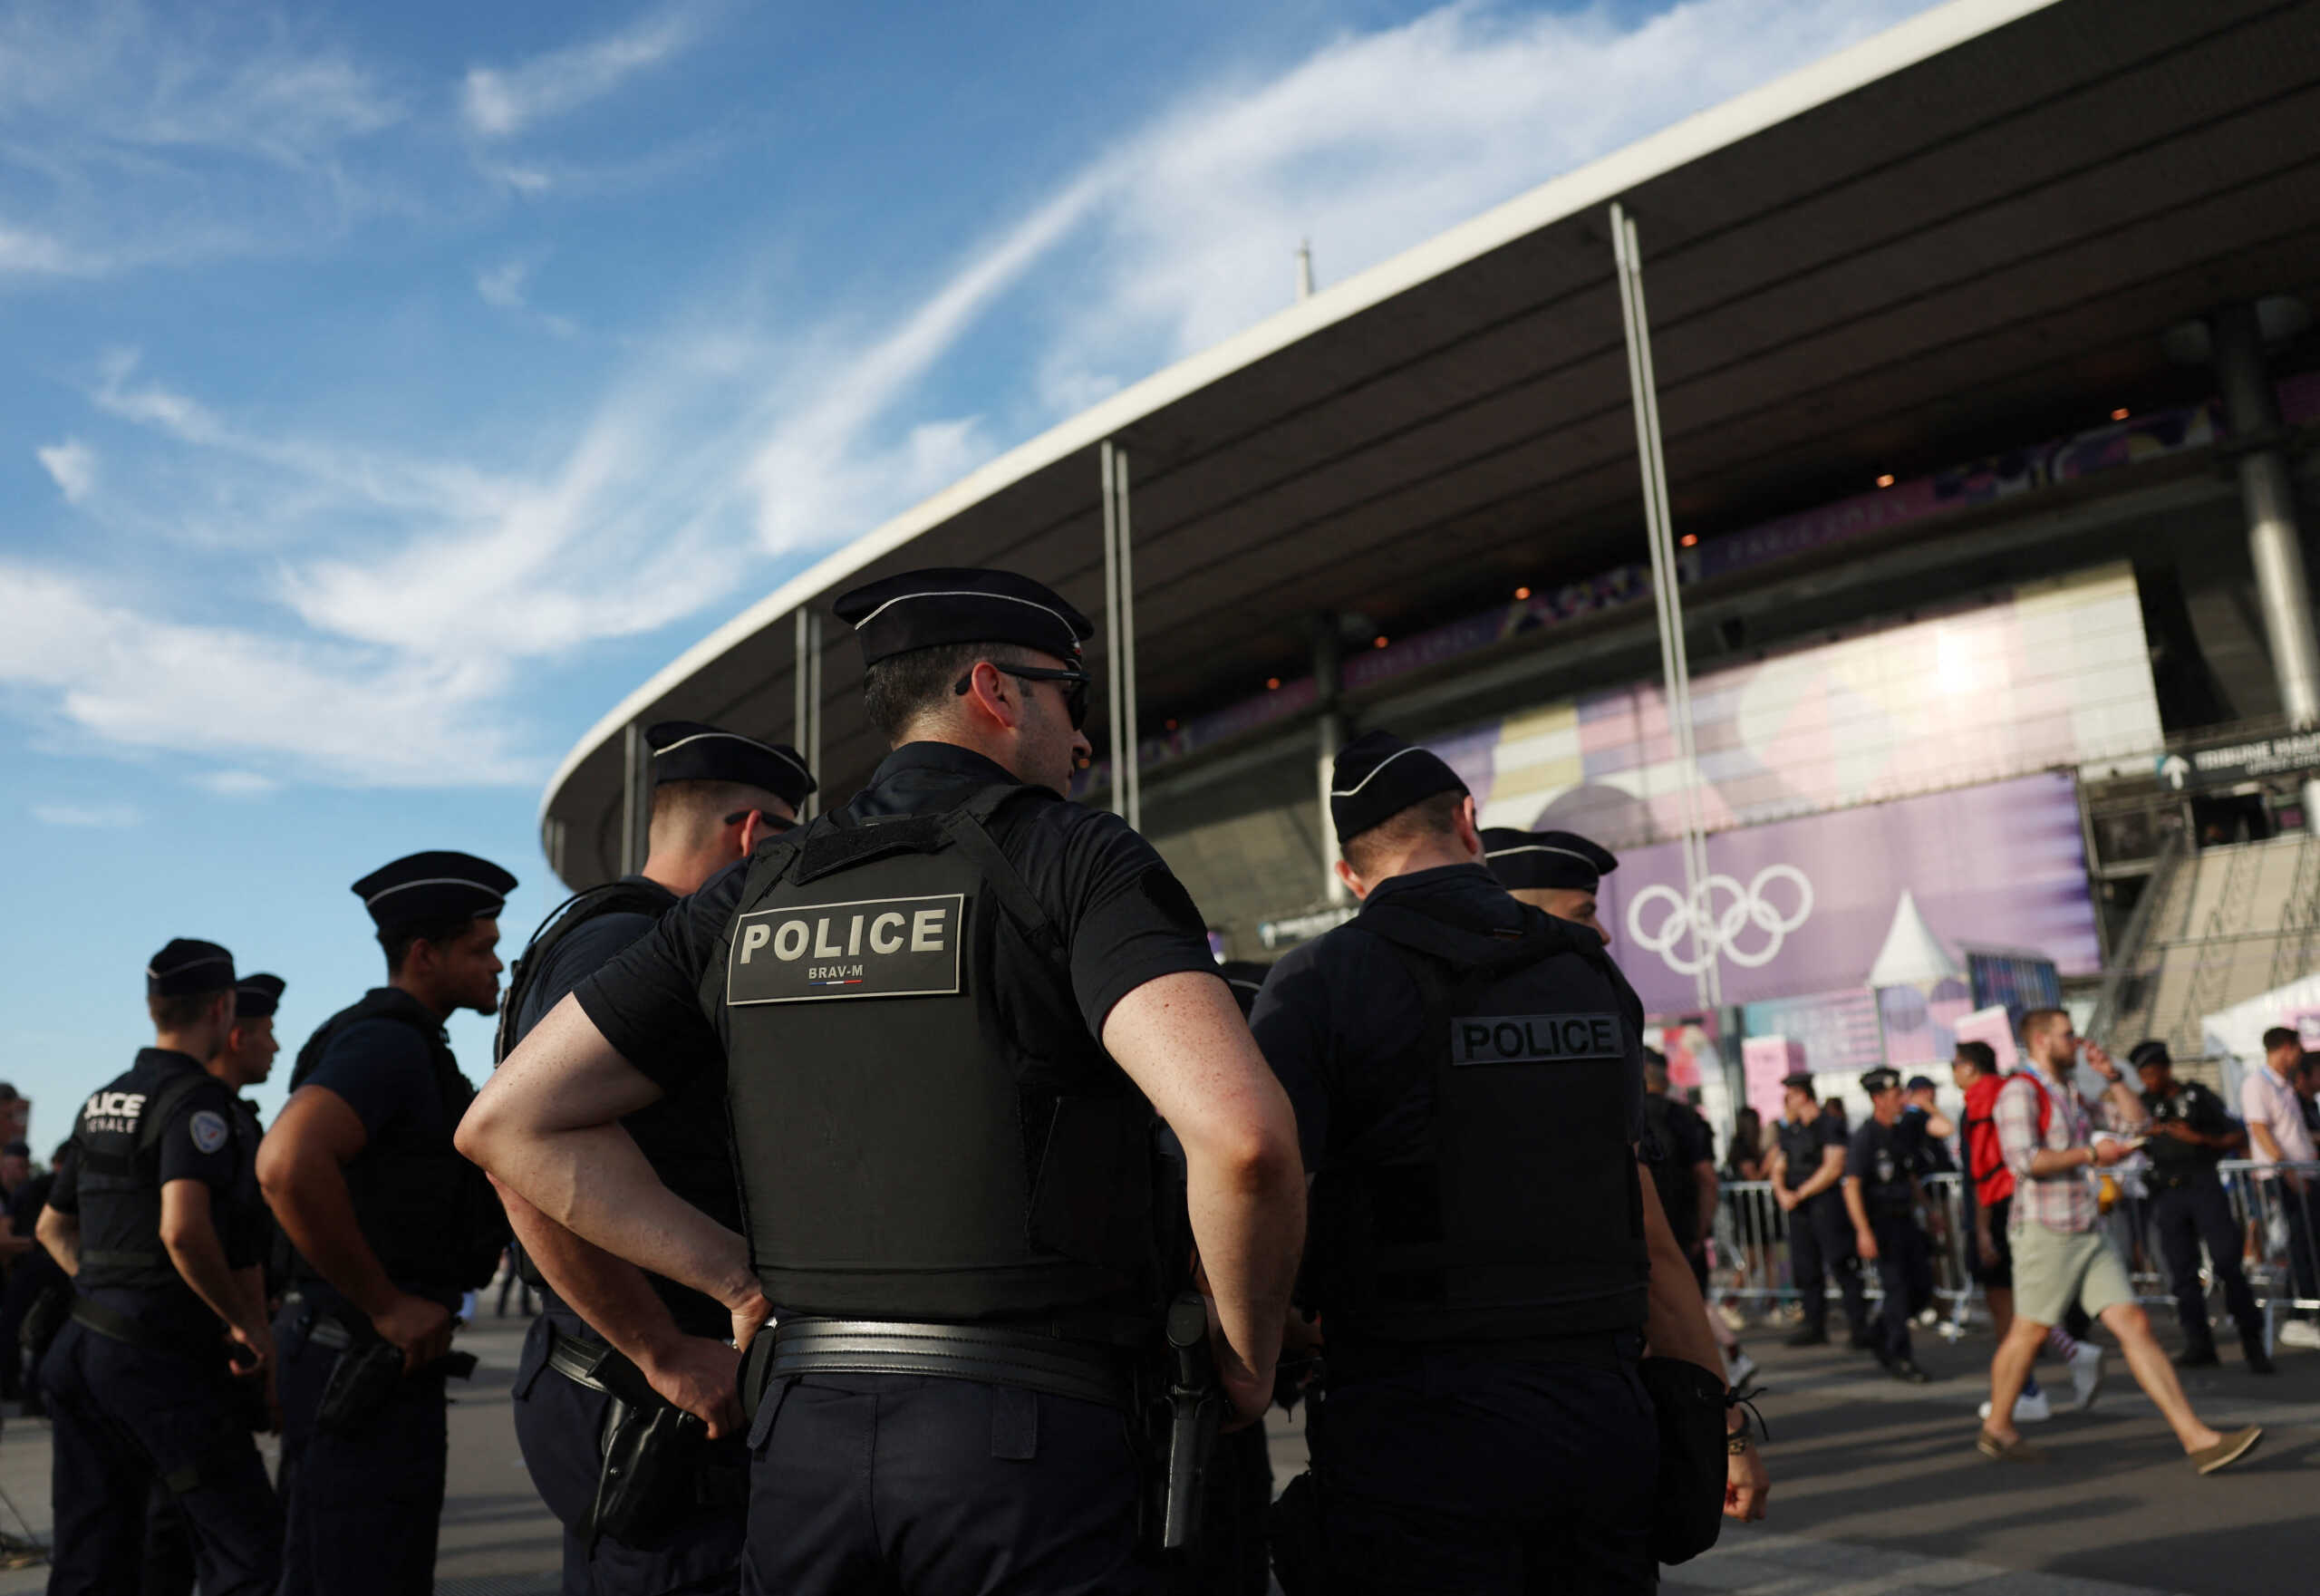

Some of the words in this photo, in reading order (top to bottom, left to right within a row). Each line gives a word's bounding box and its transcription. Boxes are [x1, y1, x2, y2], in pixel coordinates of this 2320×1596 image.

[740, 909, 946, 964] POLICE
[808, 964, 863, 980] BRAV-M
[1463, 1020, 1613, 1059] POLICE
[83, 1091, 146, 1119] LICE
